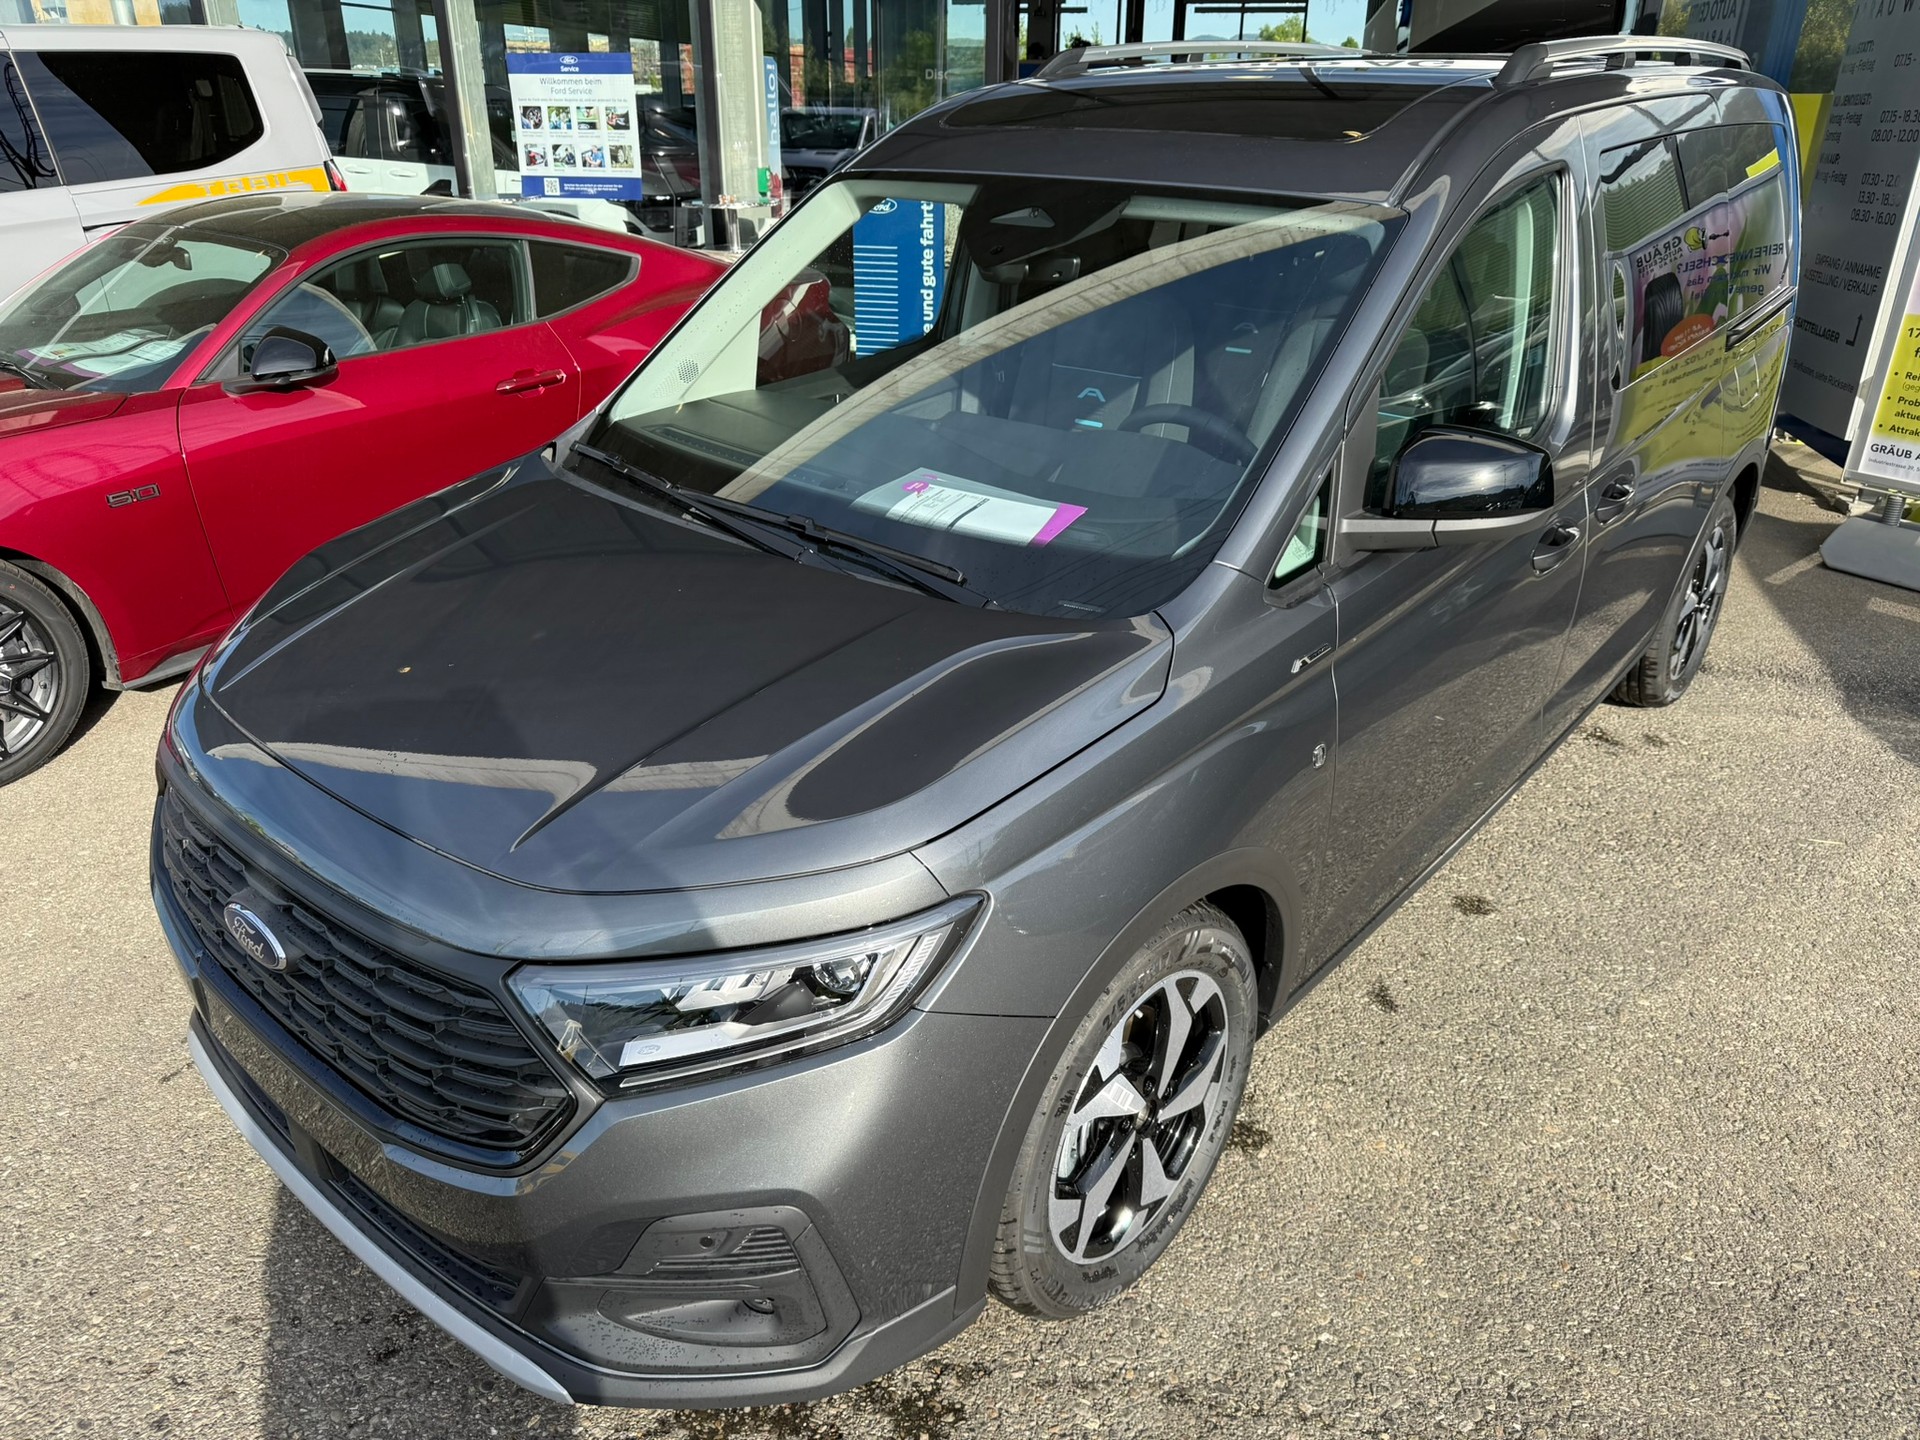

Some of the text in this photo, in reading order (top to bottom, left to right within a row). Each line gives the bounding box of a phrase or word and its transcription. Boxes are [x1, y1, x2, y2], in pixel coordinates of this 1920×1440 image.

[560, 65, 580, 73] Service
[539, 77, 602, 86] Willkommen beim
[550, 87, 593, 95] Ford Service
[1871, 129, 1893, 142] 08.00
[1897, 129, 1919, 142] 12.00
[196, 173, 292, 197] TRAIL
[1875, 211, 1897, 226] 16.00
[921, 248, 936, 288] gute
[1843, 279, 1878, 296] VERKAUF
[920, 289, 934, 321] und
[1870, 443, 1913, 459] GRÄUB
[231, 916, 266, 960] Ford
